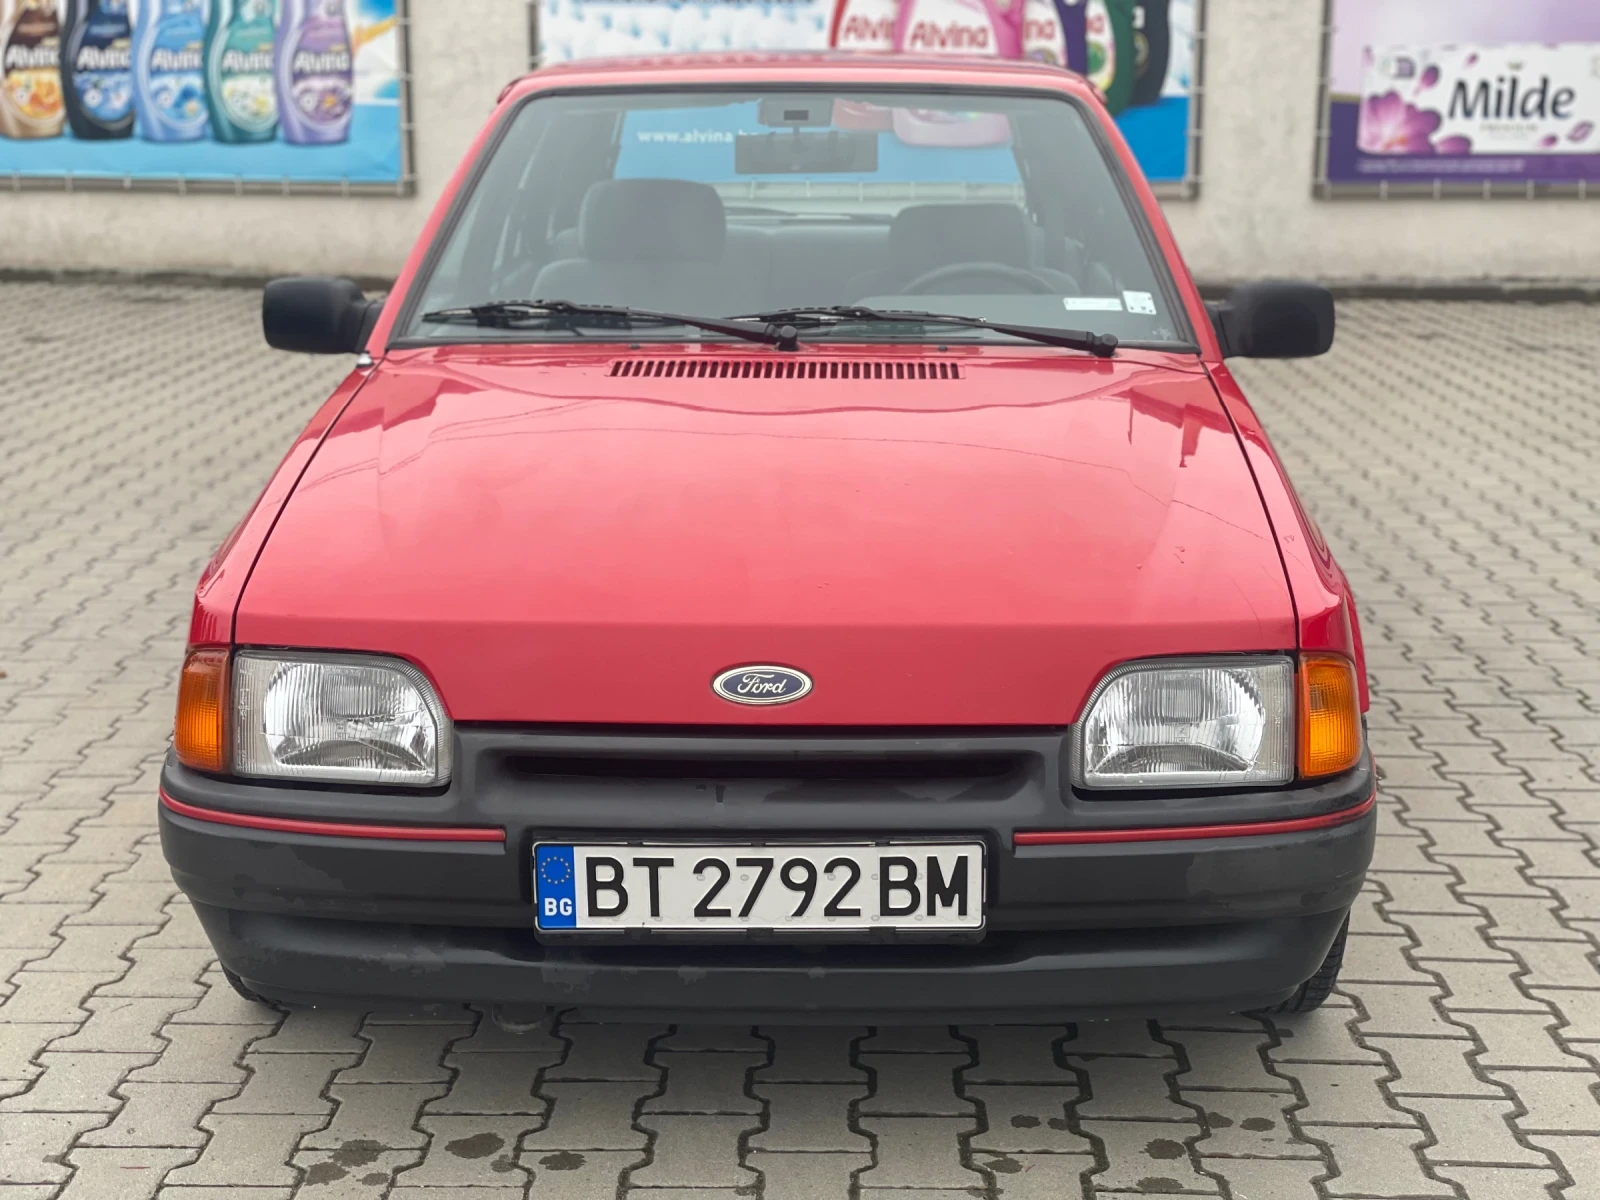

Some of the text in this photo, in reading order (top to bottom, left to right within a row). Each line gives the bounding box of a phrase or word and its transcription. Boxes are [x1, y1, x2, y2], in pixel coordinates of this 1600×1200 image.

[844, 14, 894, 41] Alvi
[911, 20, 990, 49] Alvina
[294, 49, 350, 74] Alvina
[1448, 75, 1577, 121] Milde
[636, 128, 759, 144] www.alvina
[737, 673, 788, 694] Ford
[585, 855, 969, 918] BT 2792 BM
[544, 898, 573, 916] BG
